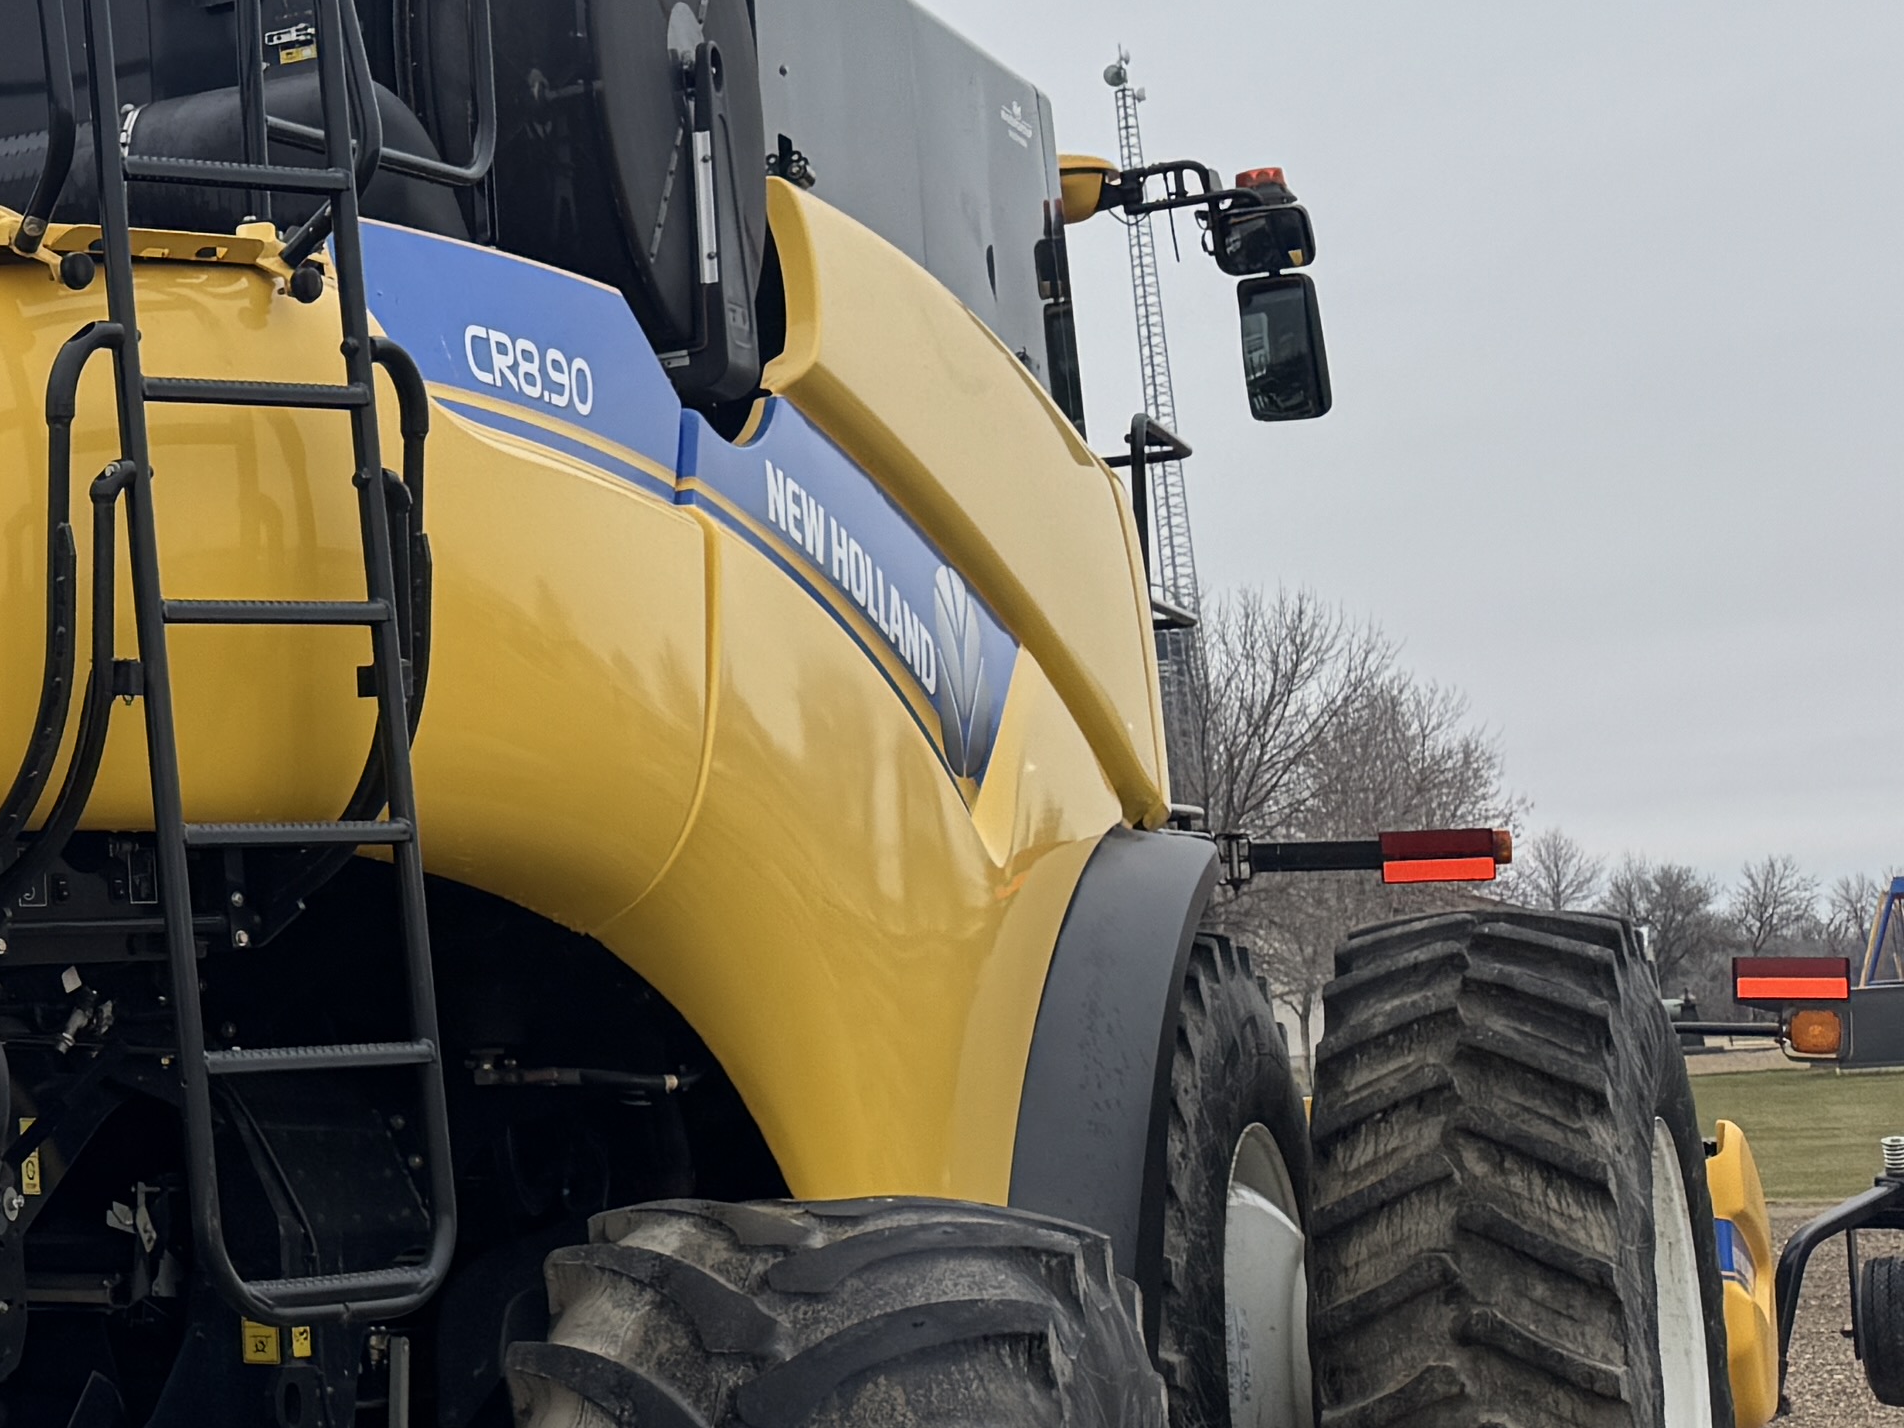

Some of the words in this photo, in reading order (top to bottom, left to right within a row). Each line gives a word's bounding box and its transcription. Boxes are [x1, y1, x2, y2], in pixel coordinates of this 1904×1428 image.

[464, 324, 593, 416] CR8.90
[765, 459, 825, 565] NEW
[829, 515, 937, 695] HOLLAND
